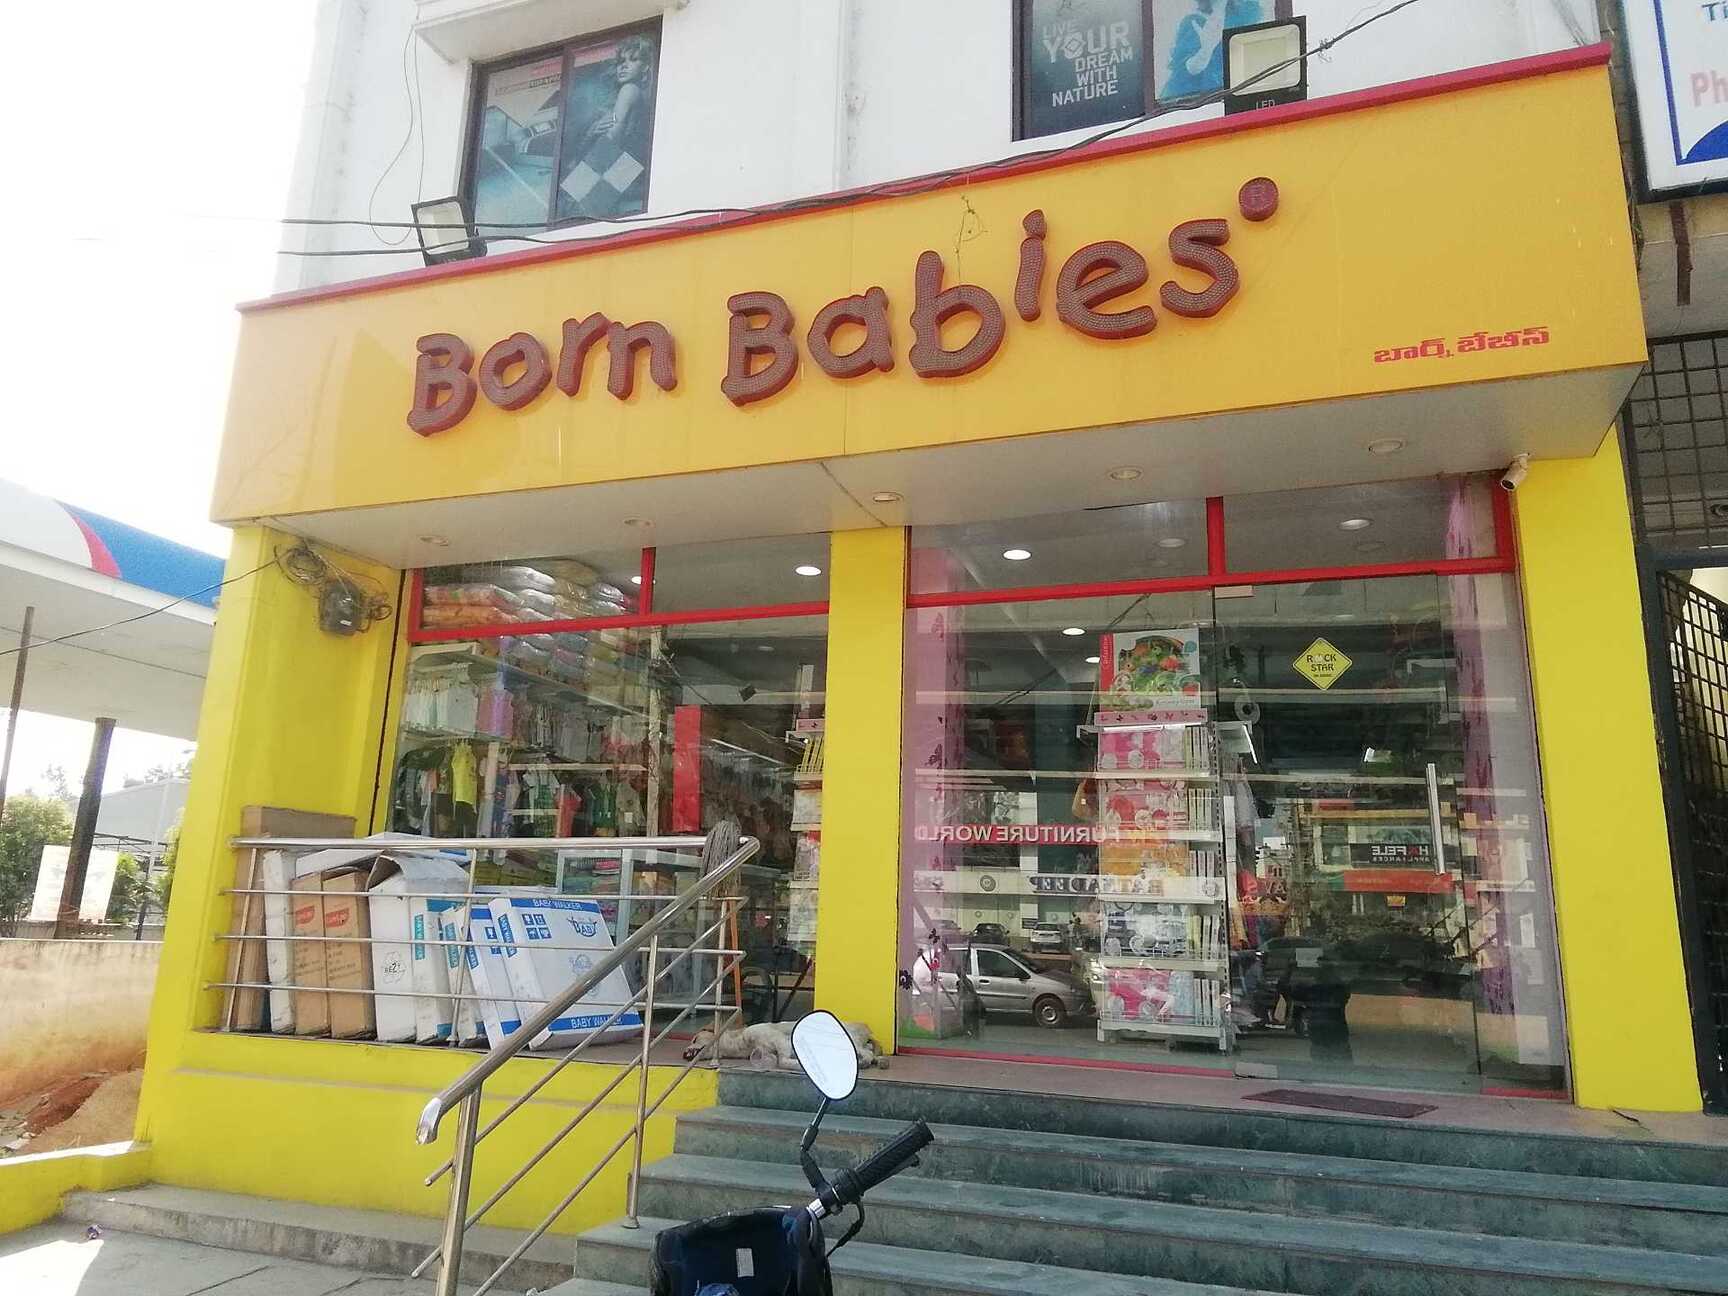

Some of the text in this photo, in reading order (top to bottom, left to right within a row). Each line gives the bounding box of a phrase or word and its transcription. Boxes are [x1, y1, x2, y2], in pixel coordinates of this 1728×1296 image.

[1043, 20, 1079, 40] LIVE
[1043, 21, 1130, 63] YOUR
[1075, 47, 1133, 72] DREAM
[1077, 65, 1117, 86] WITH
[1052, 80, 1119, 107] NATURE
[406, 312, 679, 437] Born
[1311, 664, 1334, 672] STAR
[532, 899, 551, 907] BABY
[570, 1016, 592, 1028] BABY
